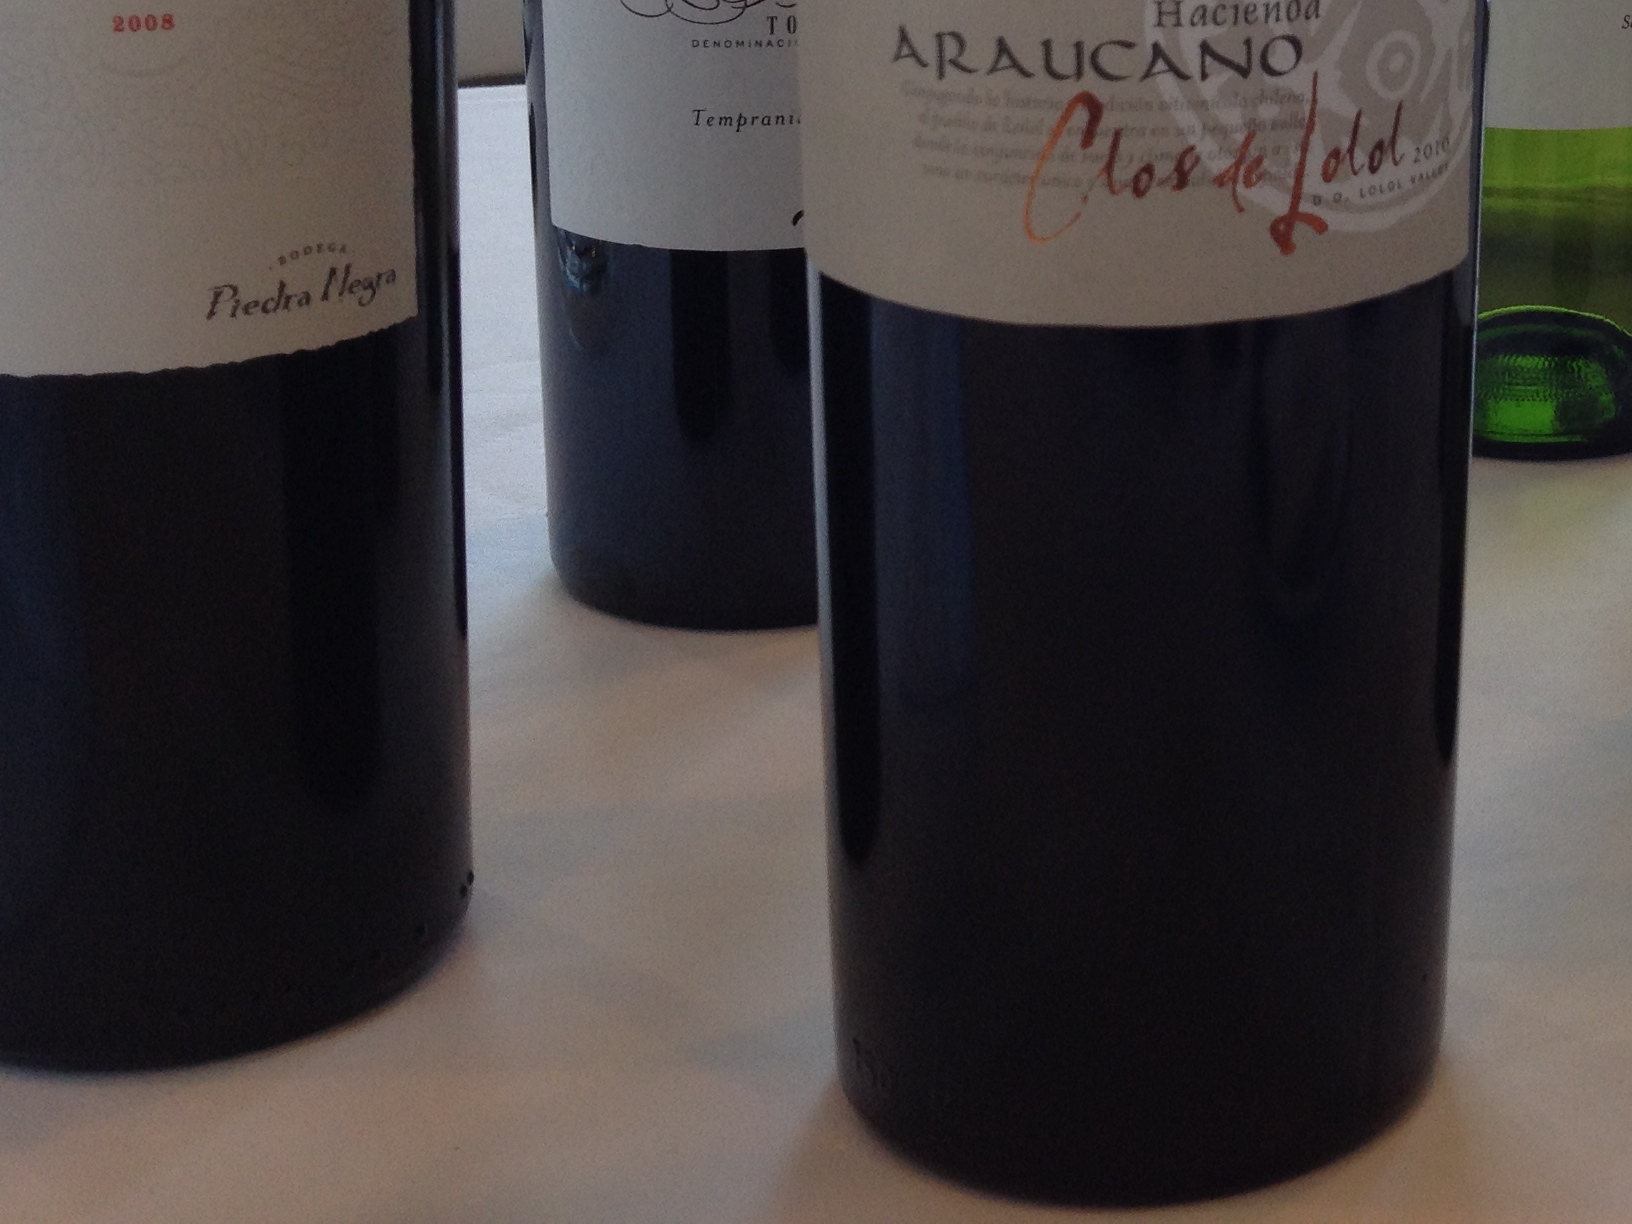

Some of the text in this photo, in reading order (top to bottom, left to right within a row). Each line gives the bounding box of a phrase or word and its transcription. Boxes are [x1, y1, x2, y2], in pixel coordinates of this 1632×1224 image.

[112, 13, 175, 33] 2008
[892, 23, 1304, 81] ARAUCANO
[1023, 91, 1200, 245] Clos
[1213, 130, 1266, 214] de
[1413, 136, 1450, 165] 2010
[277, 241, 347, 265] BODEGA
[206, 263, 396, 320] Piedra Negra
